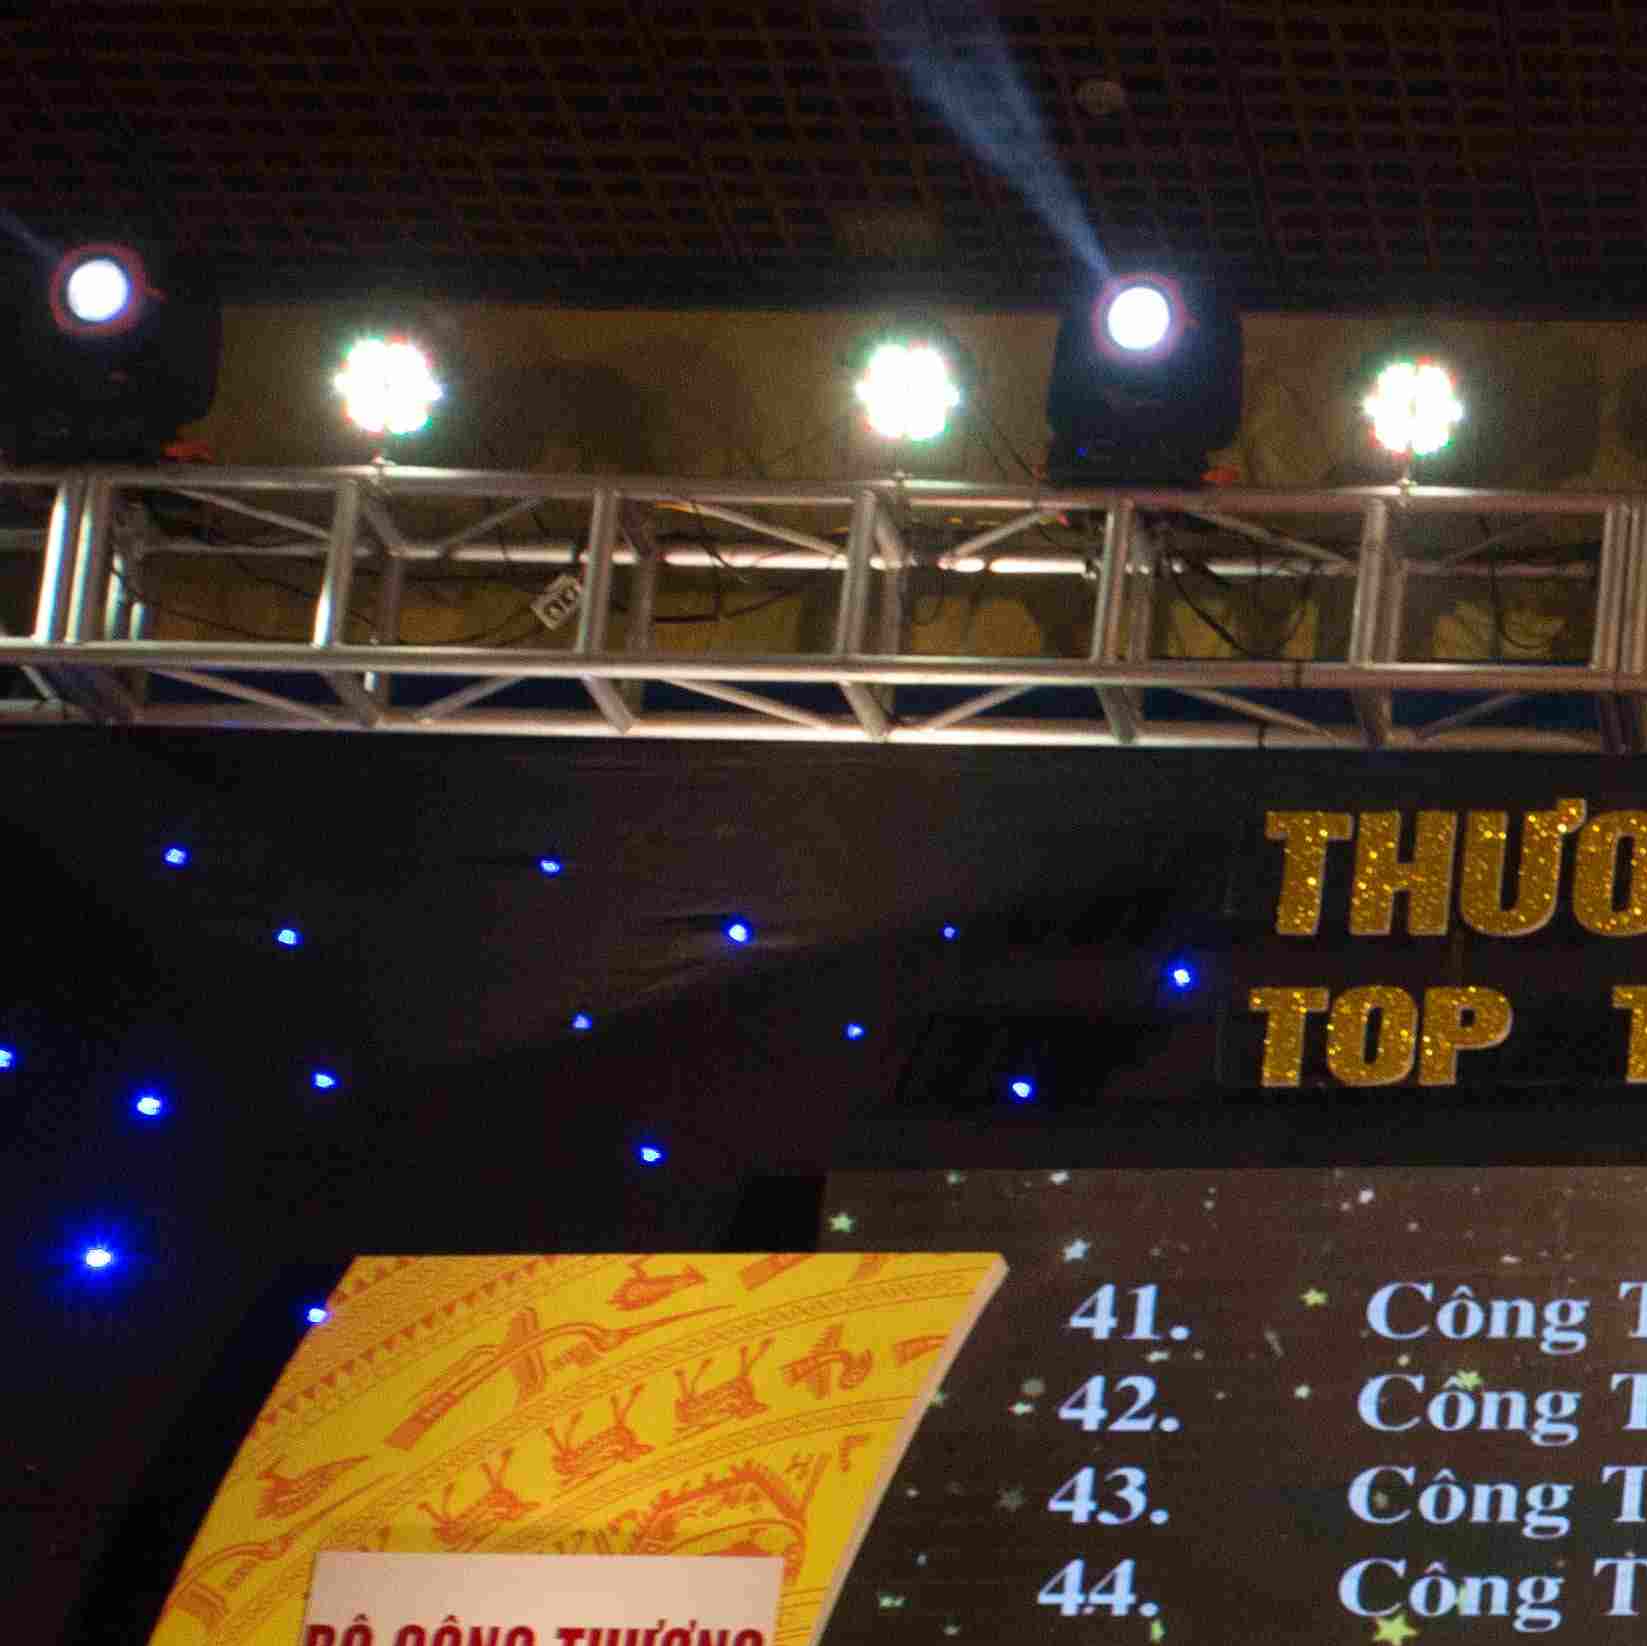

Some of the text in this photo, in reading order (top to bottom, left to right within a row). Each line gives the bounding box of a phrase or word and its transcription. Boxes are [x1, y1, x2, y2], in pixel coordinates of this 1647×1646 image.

[1250, 985, 1512, 1088] TOP
[1069, 1283, 1191, 1341] 41.
[1367, 1283, 1590, 1354] Công
[1058, 1375, 1180, 1433] 42.
[1358, 1373, 1581, 1446] Công
[1048, 1466, 1169, 1525] 43.
[1348, 1467, 1573, 1538] Công
[1037, 1558, 1159, 1618] 44.
[1338, 1558, 1563, 1632] Công
